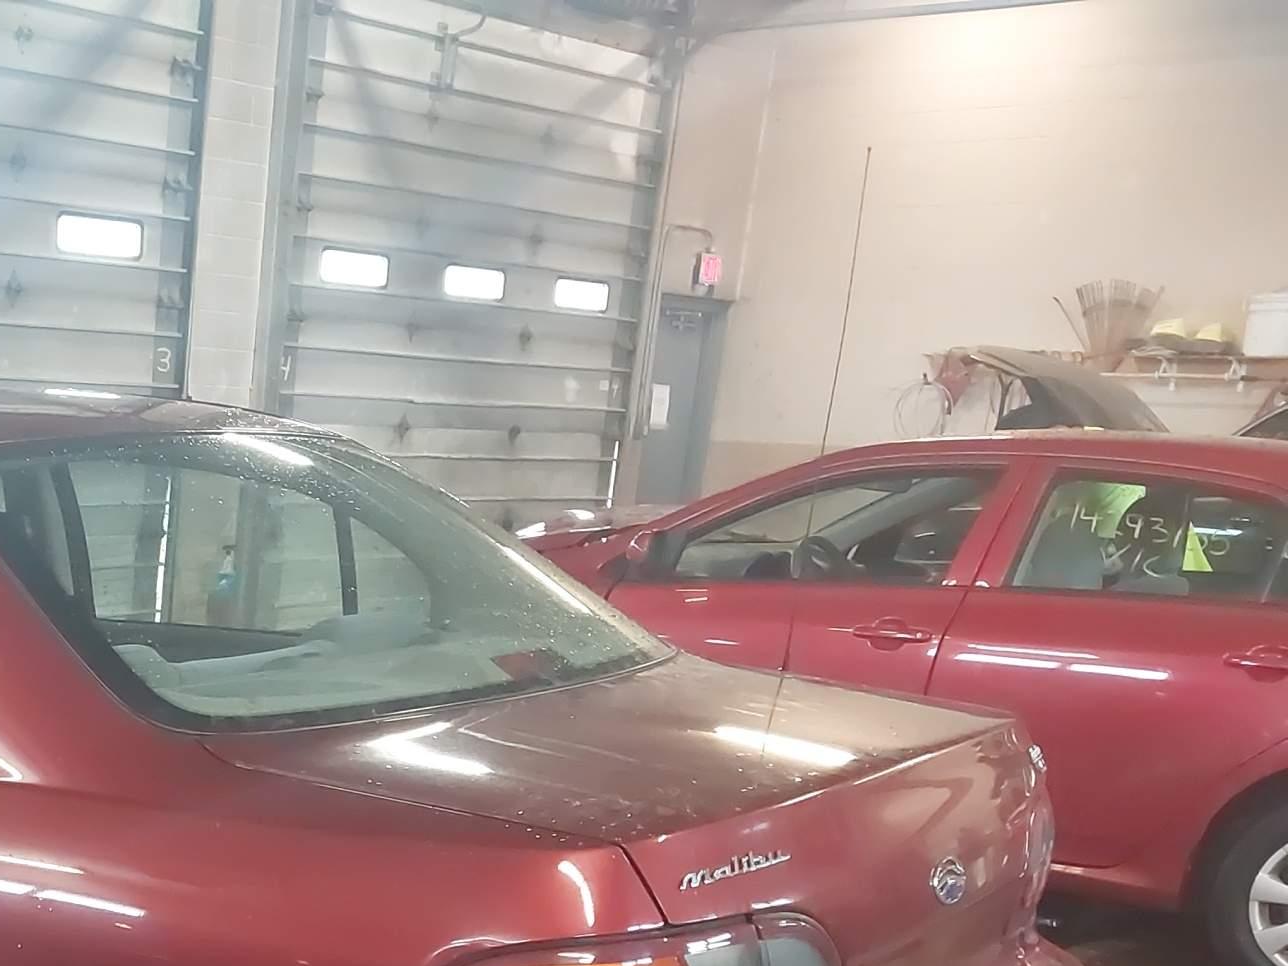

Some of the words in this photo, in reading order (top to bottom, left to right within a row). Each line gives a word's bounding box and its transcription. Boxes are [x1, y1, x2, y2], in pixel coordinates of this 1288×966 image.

[156, 346, 173, 373] 3
[280, 354, 292, 382] 4
[679, 850, 792, 891] Malibu
